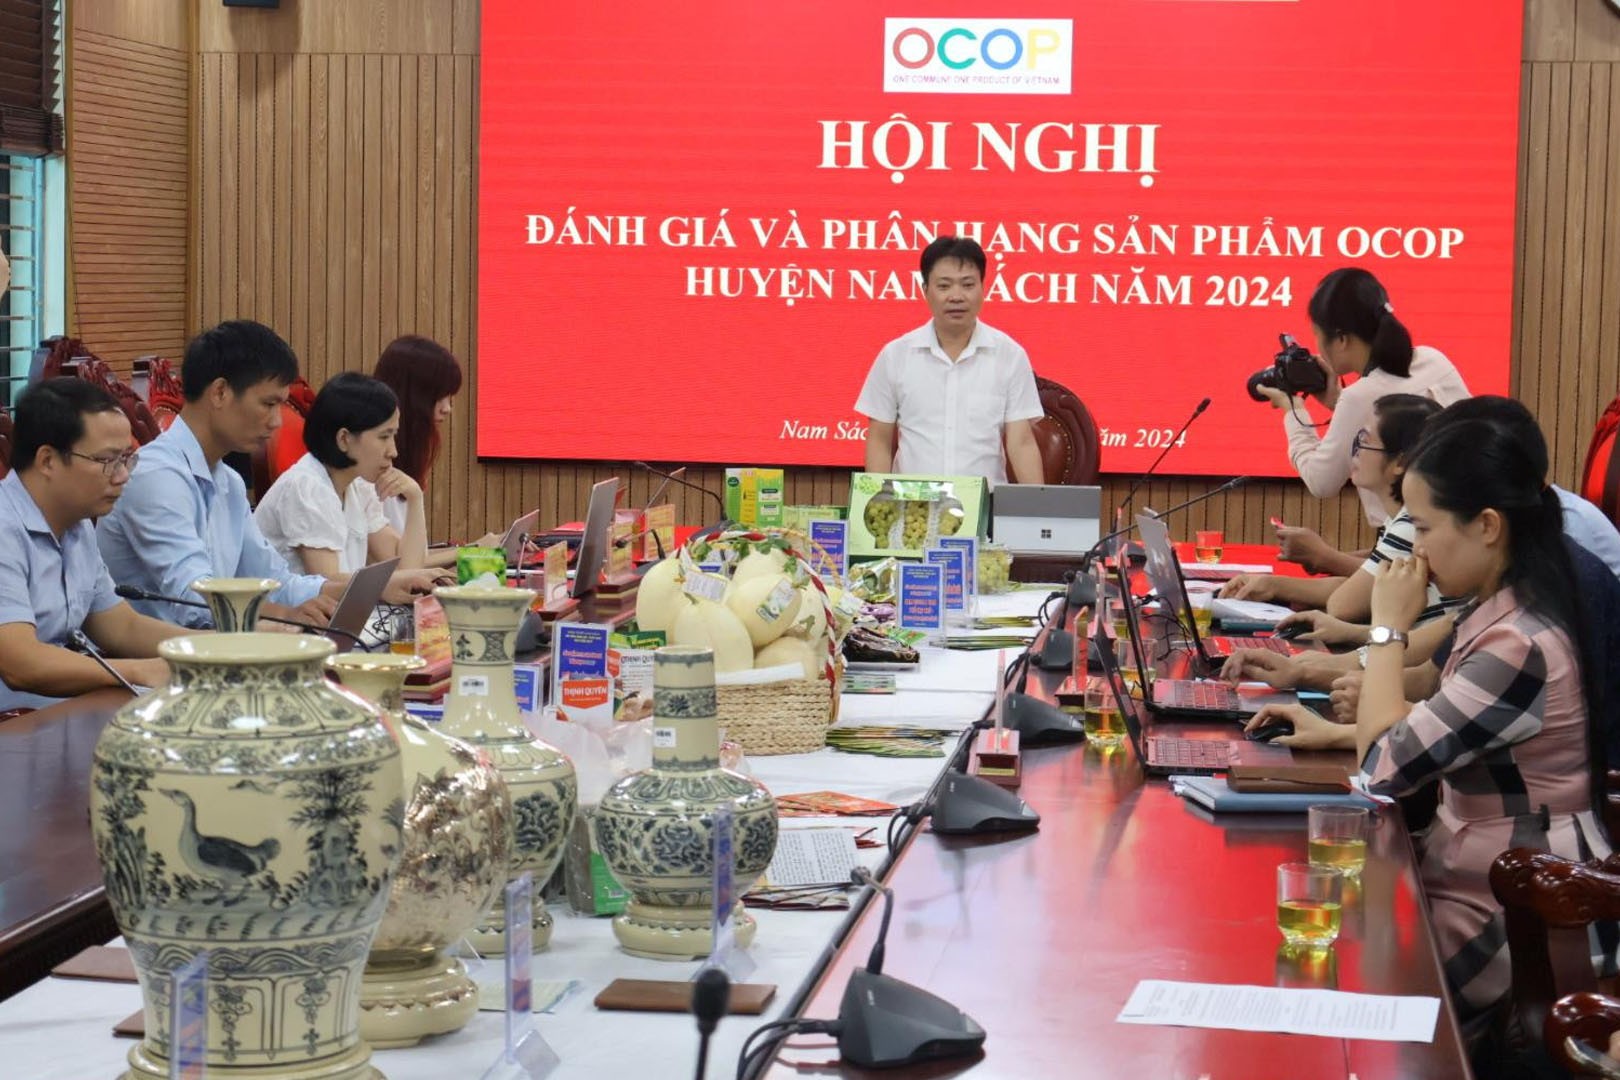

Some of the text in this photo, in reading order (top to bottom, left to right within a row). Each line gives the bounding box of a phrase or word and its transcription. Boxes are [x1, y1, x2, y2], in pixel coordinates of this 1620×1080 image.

[892, 27, 1062, 70] OCOP
[973, 76, 1010, 85] PRODUCT
[818, 112, 1161, 188] HỘI NGHỊ
[525, 206, 647, 246] ĐÁNH
[659, 208, 737, 248] GIÁ
[749, 209, 809, 249] VÀ
[821, 210, 941, 250] PHÂN
[1092, 215, 1179, 255] SẢN
[1192, 217, 1325, 257] PHẨM
[1336, 226, 1465, 259] OCOP
[685, 263, 835, 307] HUYỆN
[984, 263, 1078, 304] ÁCH
[1091, 266, 1193, 305] NĂM
[1205, 275, 1293, 307] 2024
[779, 419, 1187, 448] Nam Sác ăm 2024
